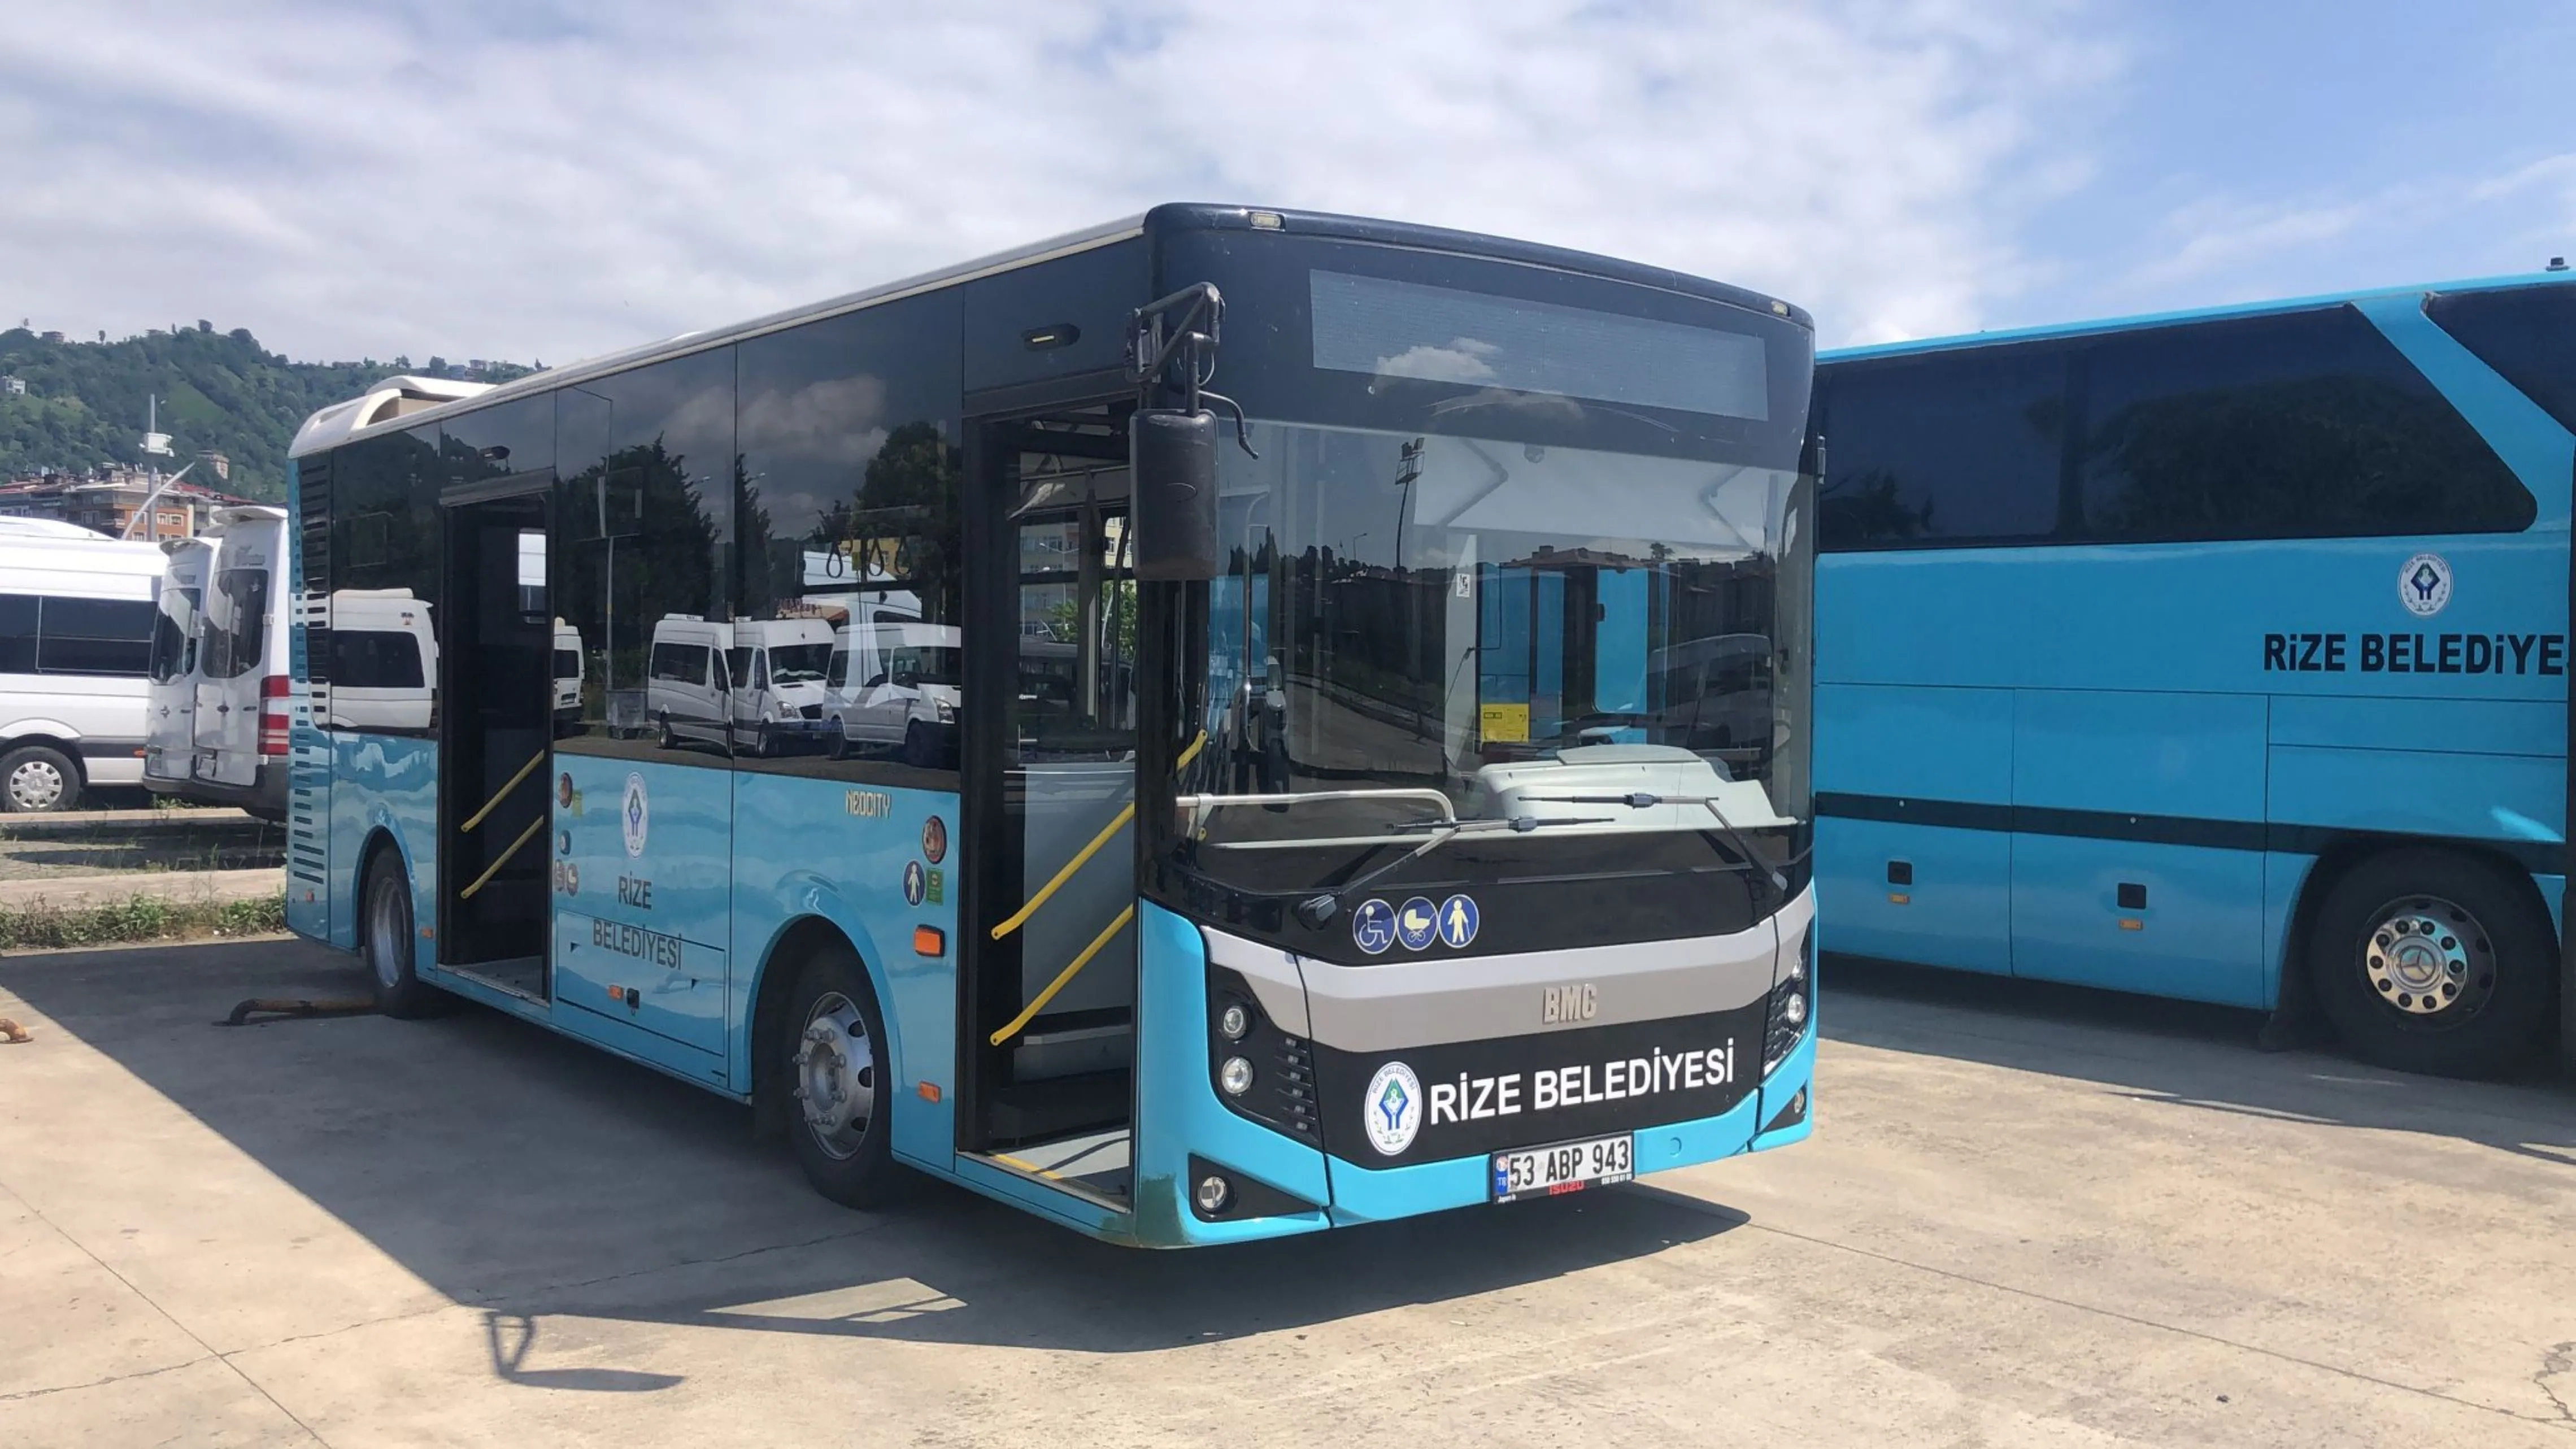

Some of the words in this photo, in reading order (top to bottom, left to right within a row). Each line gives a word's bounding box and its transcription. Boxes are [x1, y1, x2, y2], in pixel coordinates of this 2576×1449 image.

[619, 870, 652, 910] RİZE
[593, 919, 682, 971] BELEDİYESİ
[1542, 983, 1598, 1025] BMC
[1430, 1072, 1521, 1125] RİZE
[1534, 1037, 1734, 1110] BELEDİYESİ
[1509, 1155, 1535, 1187] 53
[1546, 1147, 1583, 1183] ABP
[1592, 1139, 1629, 1174] 943
